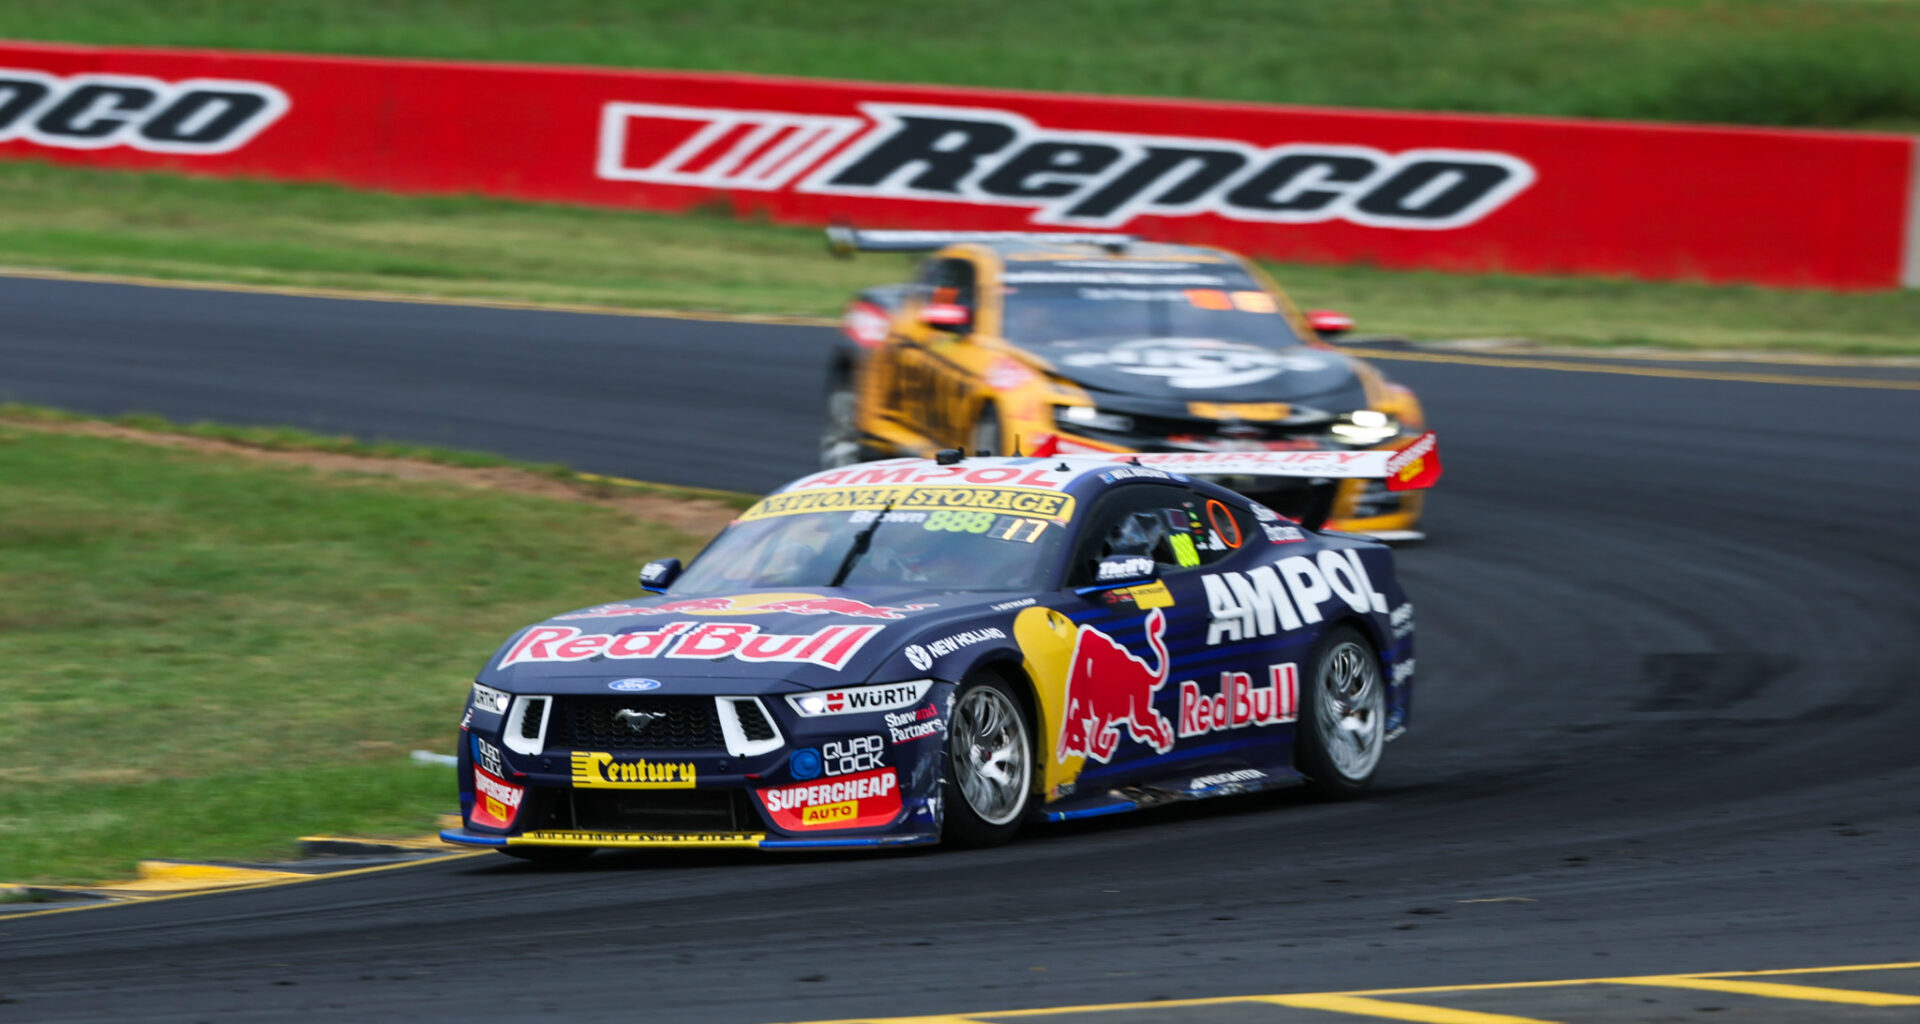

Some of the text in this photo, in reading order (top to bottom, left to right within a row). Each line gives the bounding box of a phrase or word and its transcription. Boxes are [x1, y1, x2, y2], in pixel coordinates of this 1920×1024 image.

[818, 108, 1520, 220] Repco
[800, 467, 1058, 488] AMPOL
[757, 488, 1058, 515] NATIONAL STORAGE
[848, 510, 1049, 543] Brown 888 17
[1201, 548, 1390, 646] AMPOL
[926, 627, 1006, 658] NEW HOLLAND
[889, 718, 946, 743] Partners
[822, 735, 883, 760] QUAD
[590, 752, 696, 788] Century
[824, 751, 885, 776] LOCK
[767, 772, 896, 812] SUPERCHEAP
[808, 806, 852, 821] AUTO
